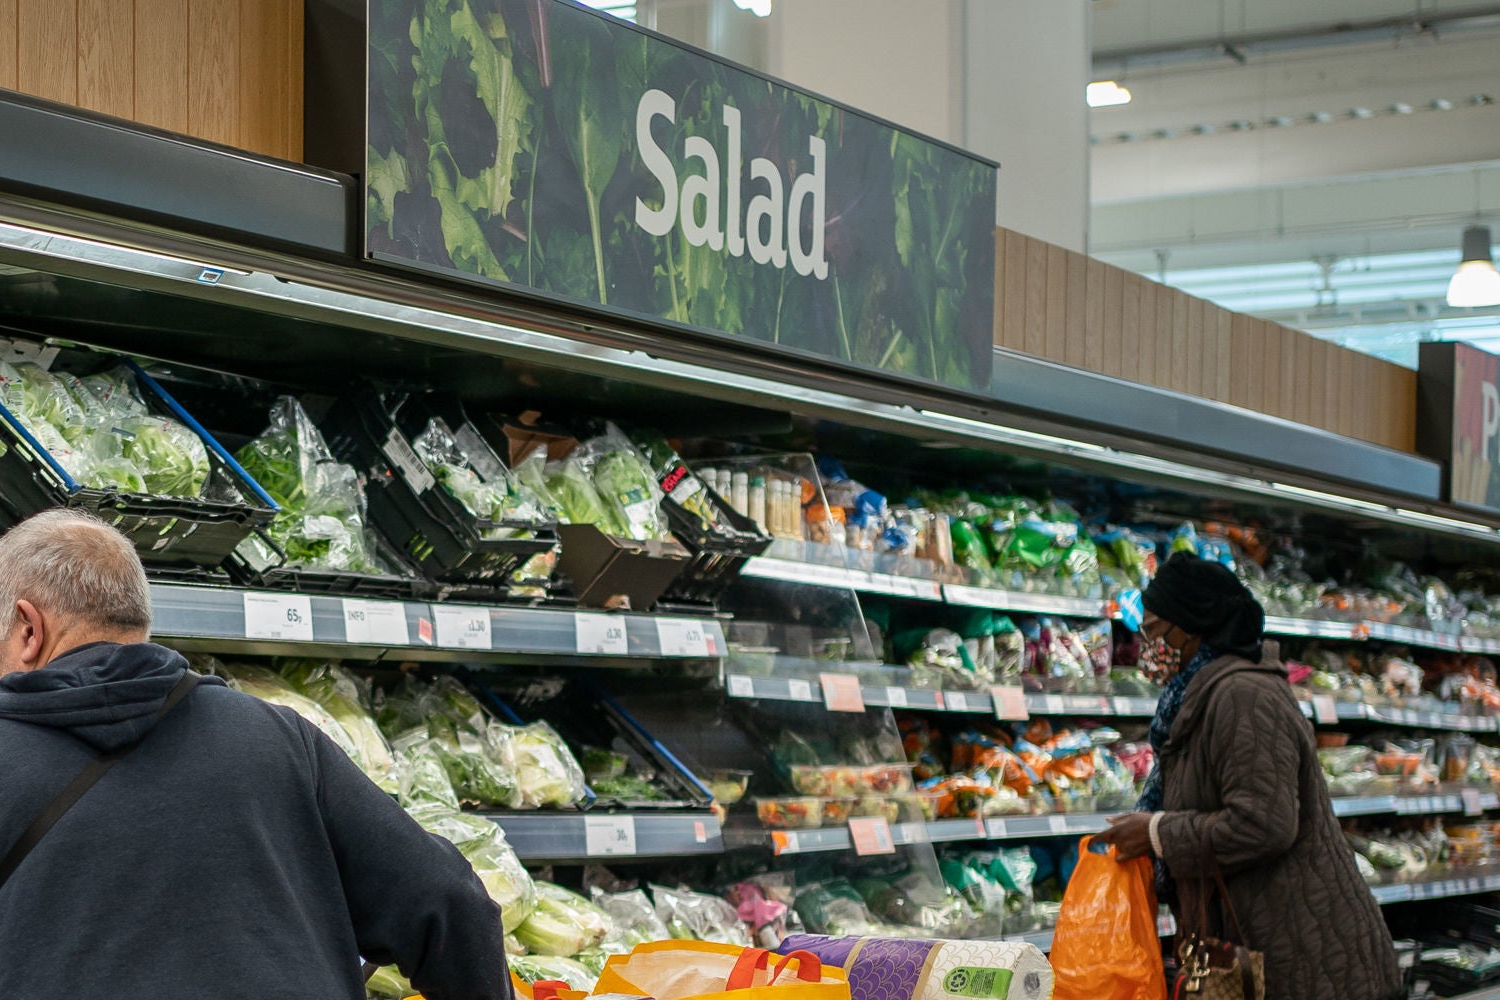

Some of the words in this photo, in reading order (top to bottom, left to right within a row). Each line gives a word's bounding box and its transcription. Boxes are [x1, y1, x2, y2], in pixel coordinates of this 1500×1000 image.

[634, 88, 829, 281] Salad
[287, 608, 302, 624] 65p
[348, 610, 365, 621] INFO
